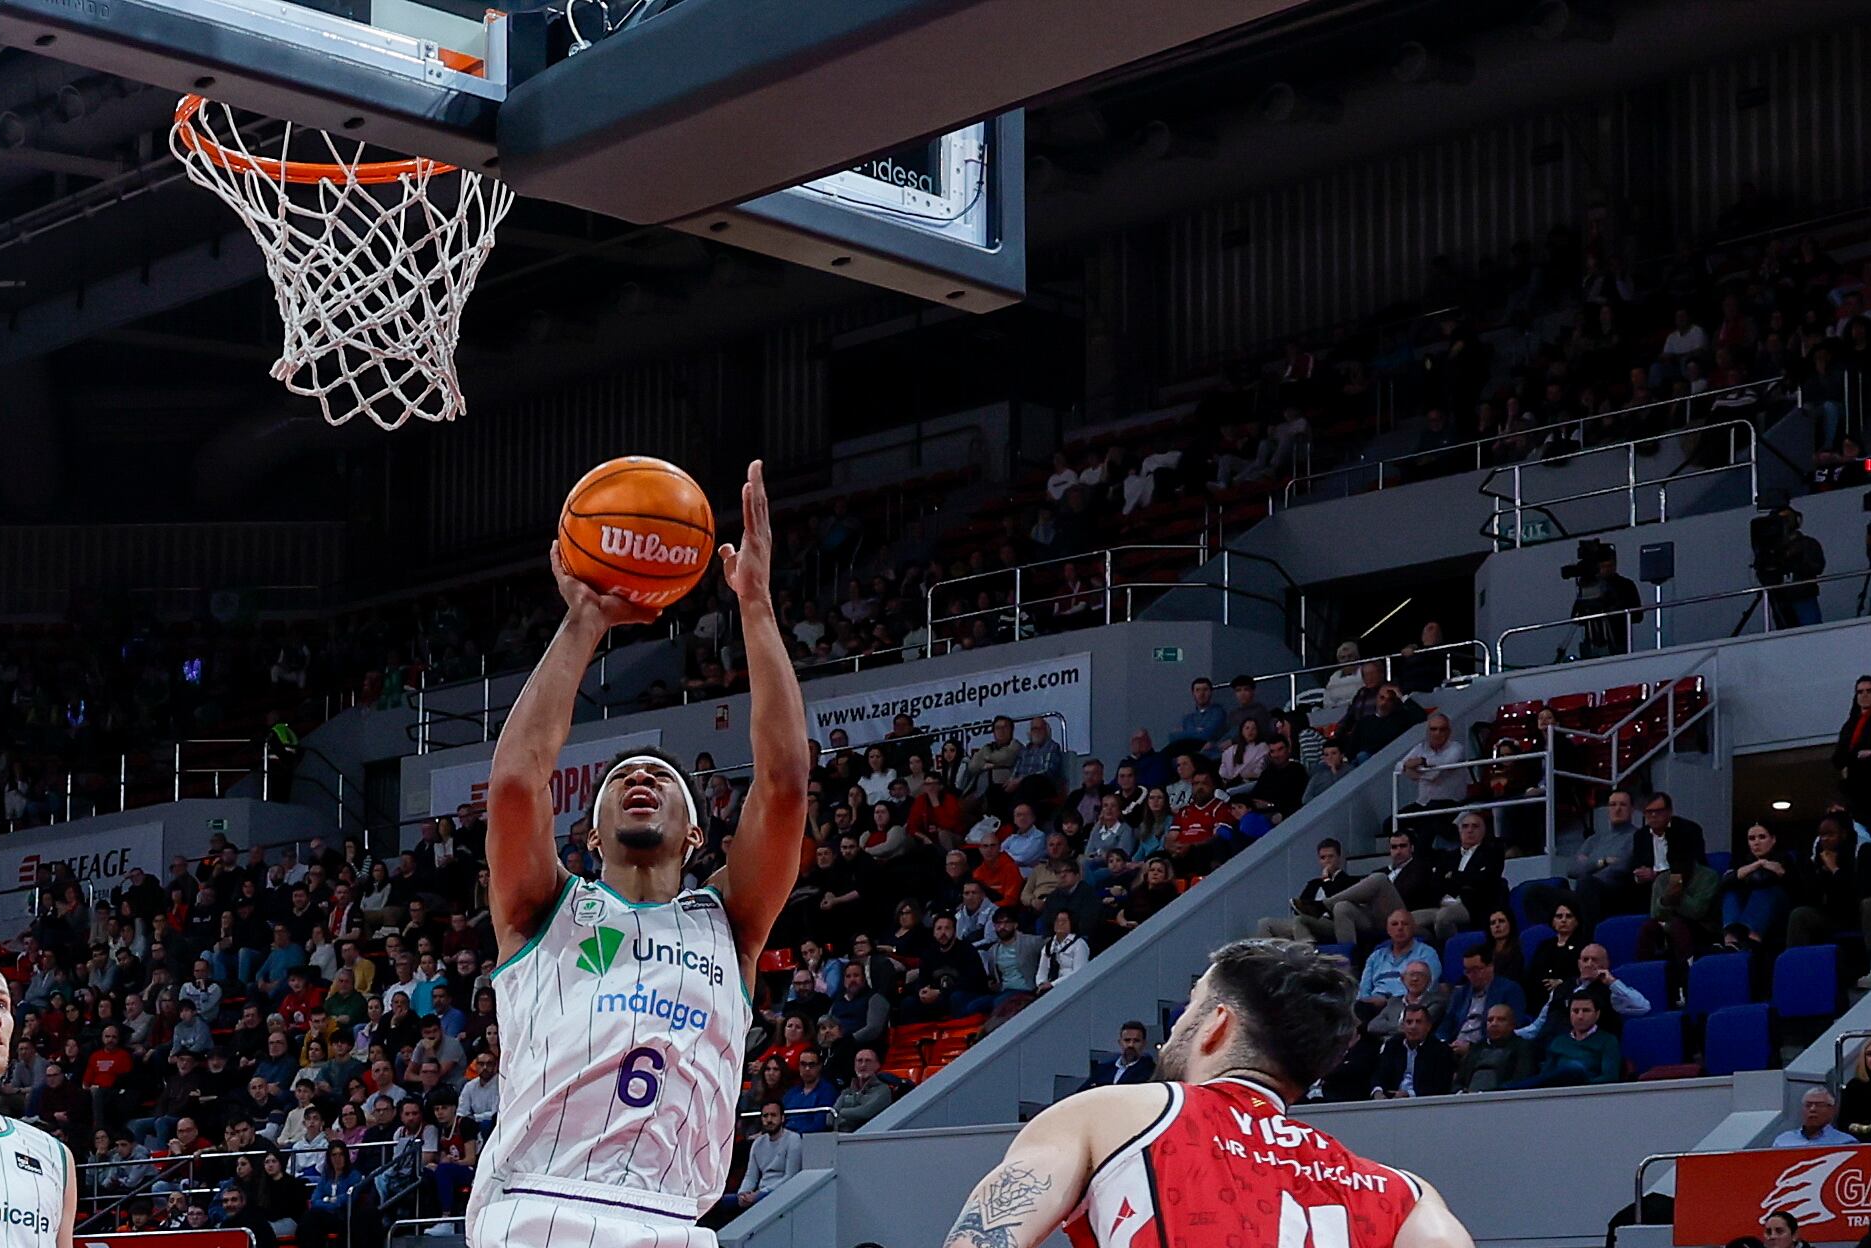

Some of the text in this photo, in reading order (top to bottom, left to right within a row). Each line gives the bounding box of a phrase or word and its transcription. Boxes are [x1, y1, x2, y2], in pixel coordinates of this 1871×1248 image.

[601, 525, 699, 565] Wilson
[817, 667, 1080, 728] www.zaragozadeporte.com
[633, 938, 724, 986] Unicaja
[618, 1047, 664, 1108] 6
